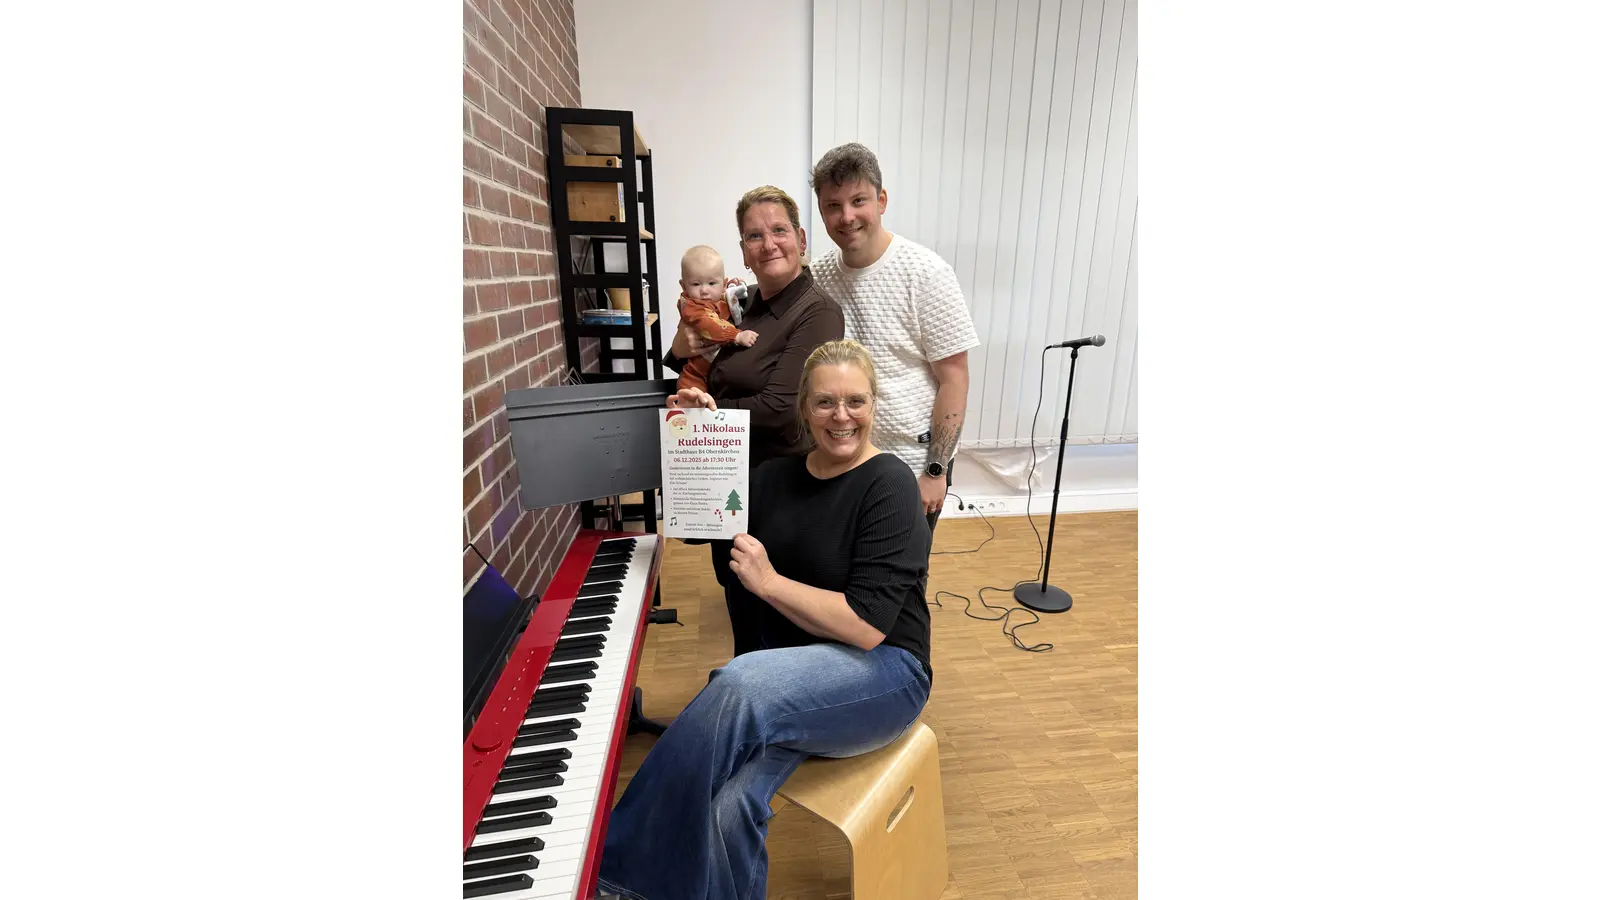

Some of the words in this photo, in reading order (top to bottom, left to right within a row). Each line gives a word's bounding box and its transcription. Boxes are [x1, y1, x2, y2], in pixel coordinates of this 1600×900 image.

[693, 424, 700, 433] 1.
[702, 423, 746, 433] Nikolaus
[678, 437, 742, 448] Rudelsingen
